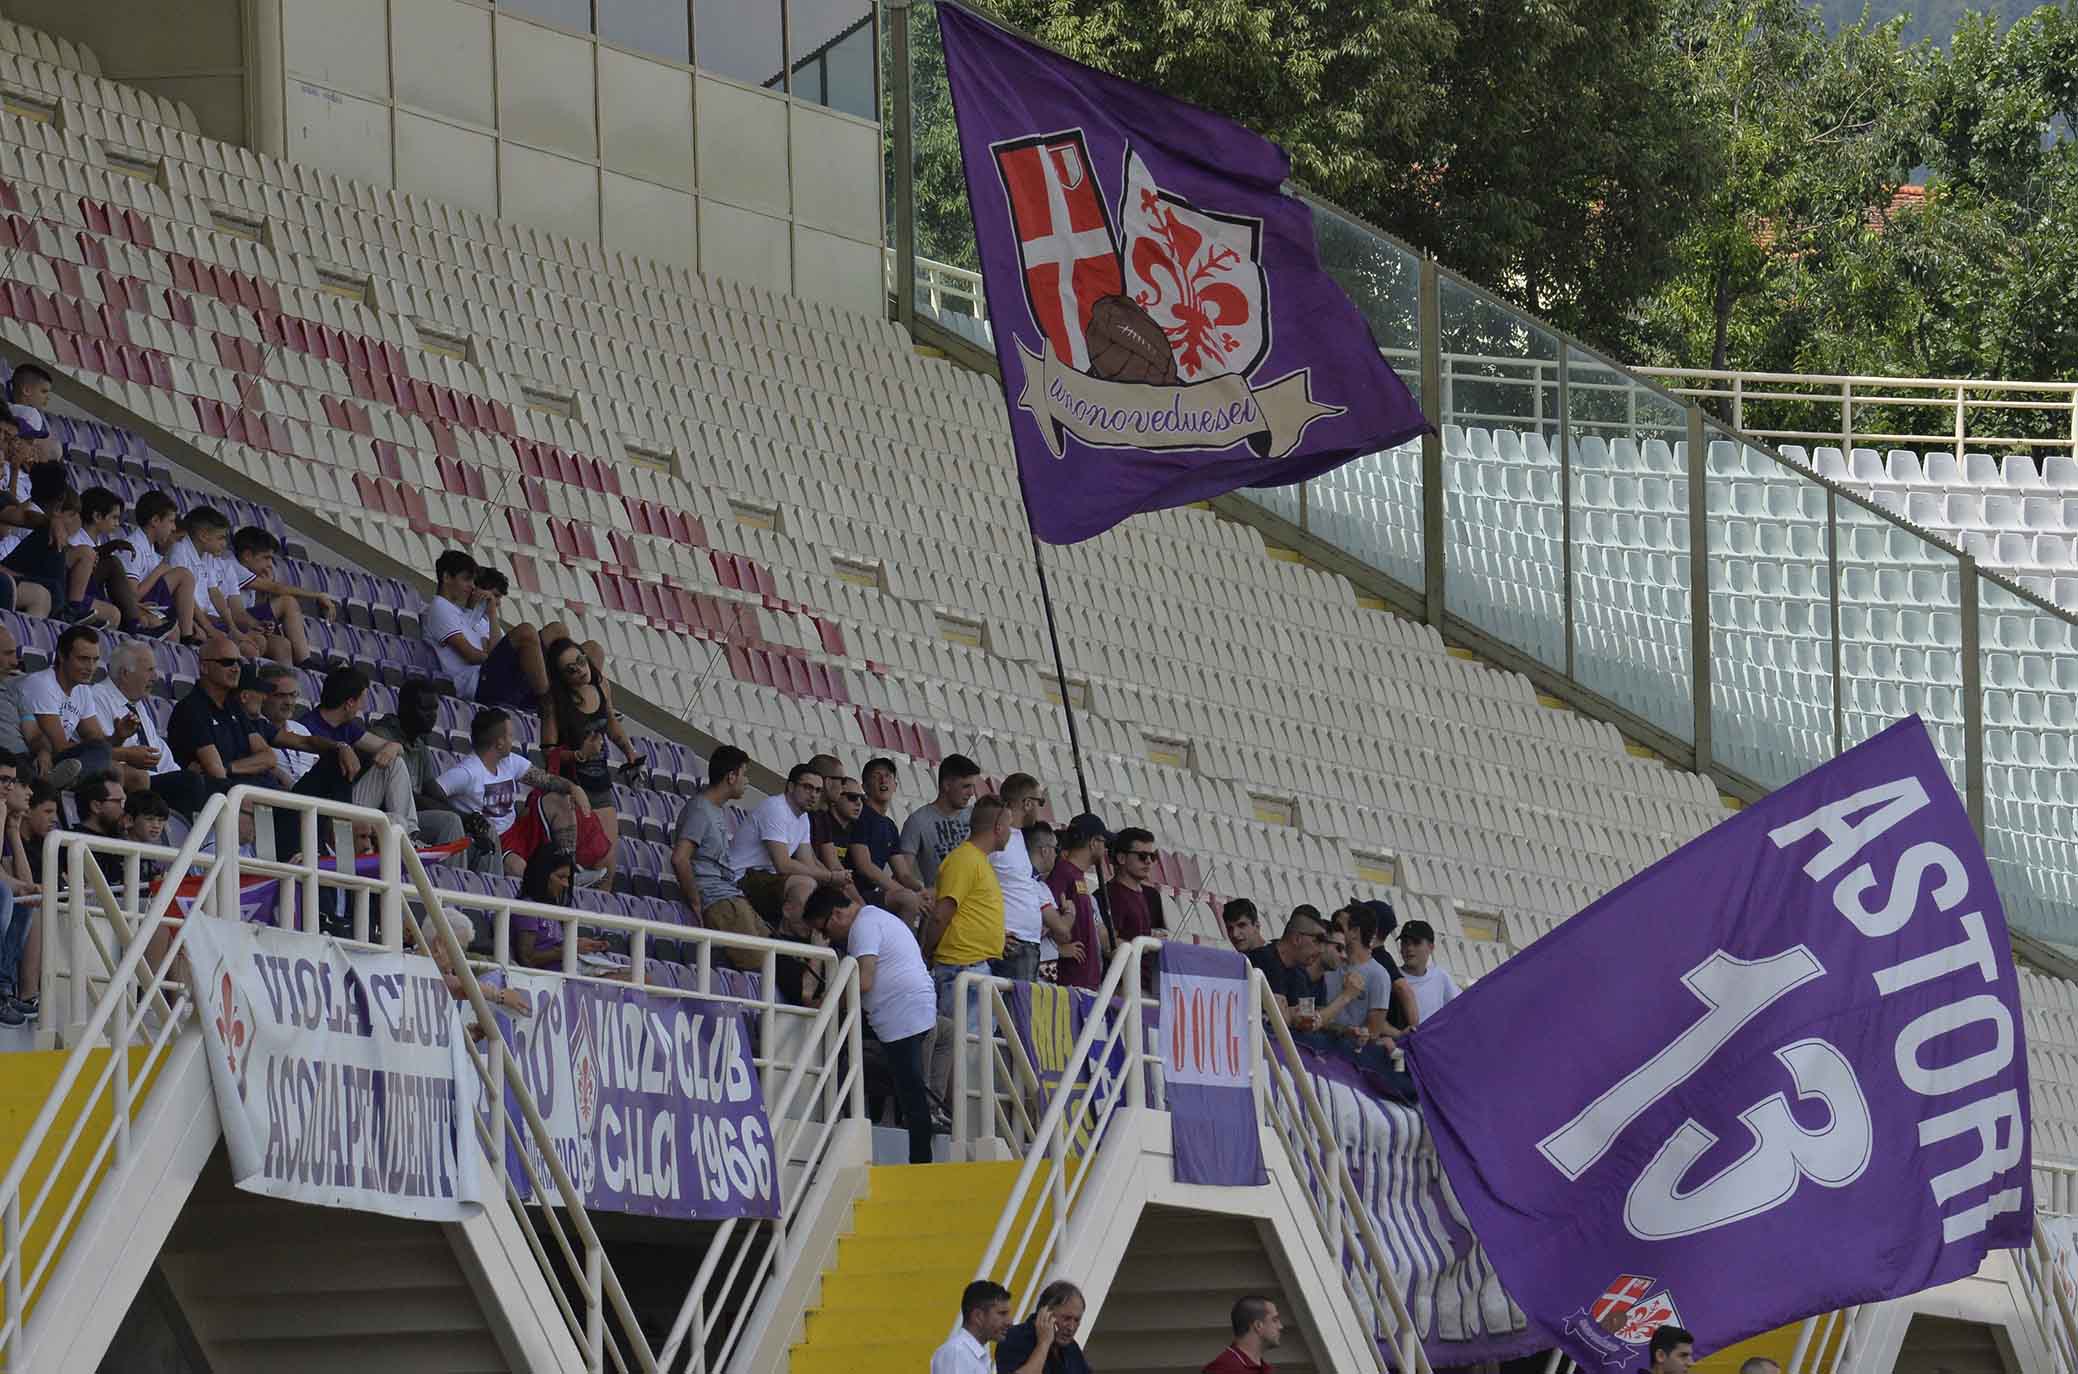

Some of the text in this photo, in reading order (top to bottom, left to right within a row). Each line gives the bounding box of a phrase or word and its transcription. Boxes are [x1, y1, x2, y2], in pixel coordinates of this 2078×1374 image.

[253, 953, 451, 1048] VIOLA CLUB
[595, 1000, 752, 1104] VIOLA CLUB
[1768, 776, 2024, 1244] ASTORI
[1536, 943, 1873, 1241] 13
[688, 1114, 773, 1202] 1966
